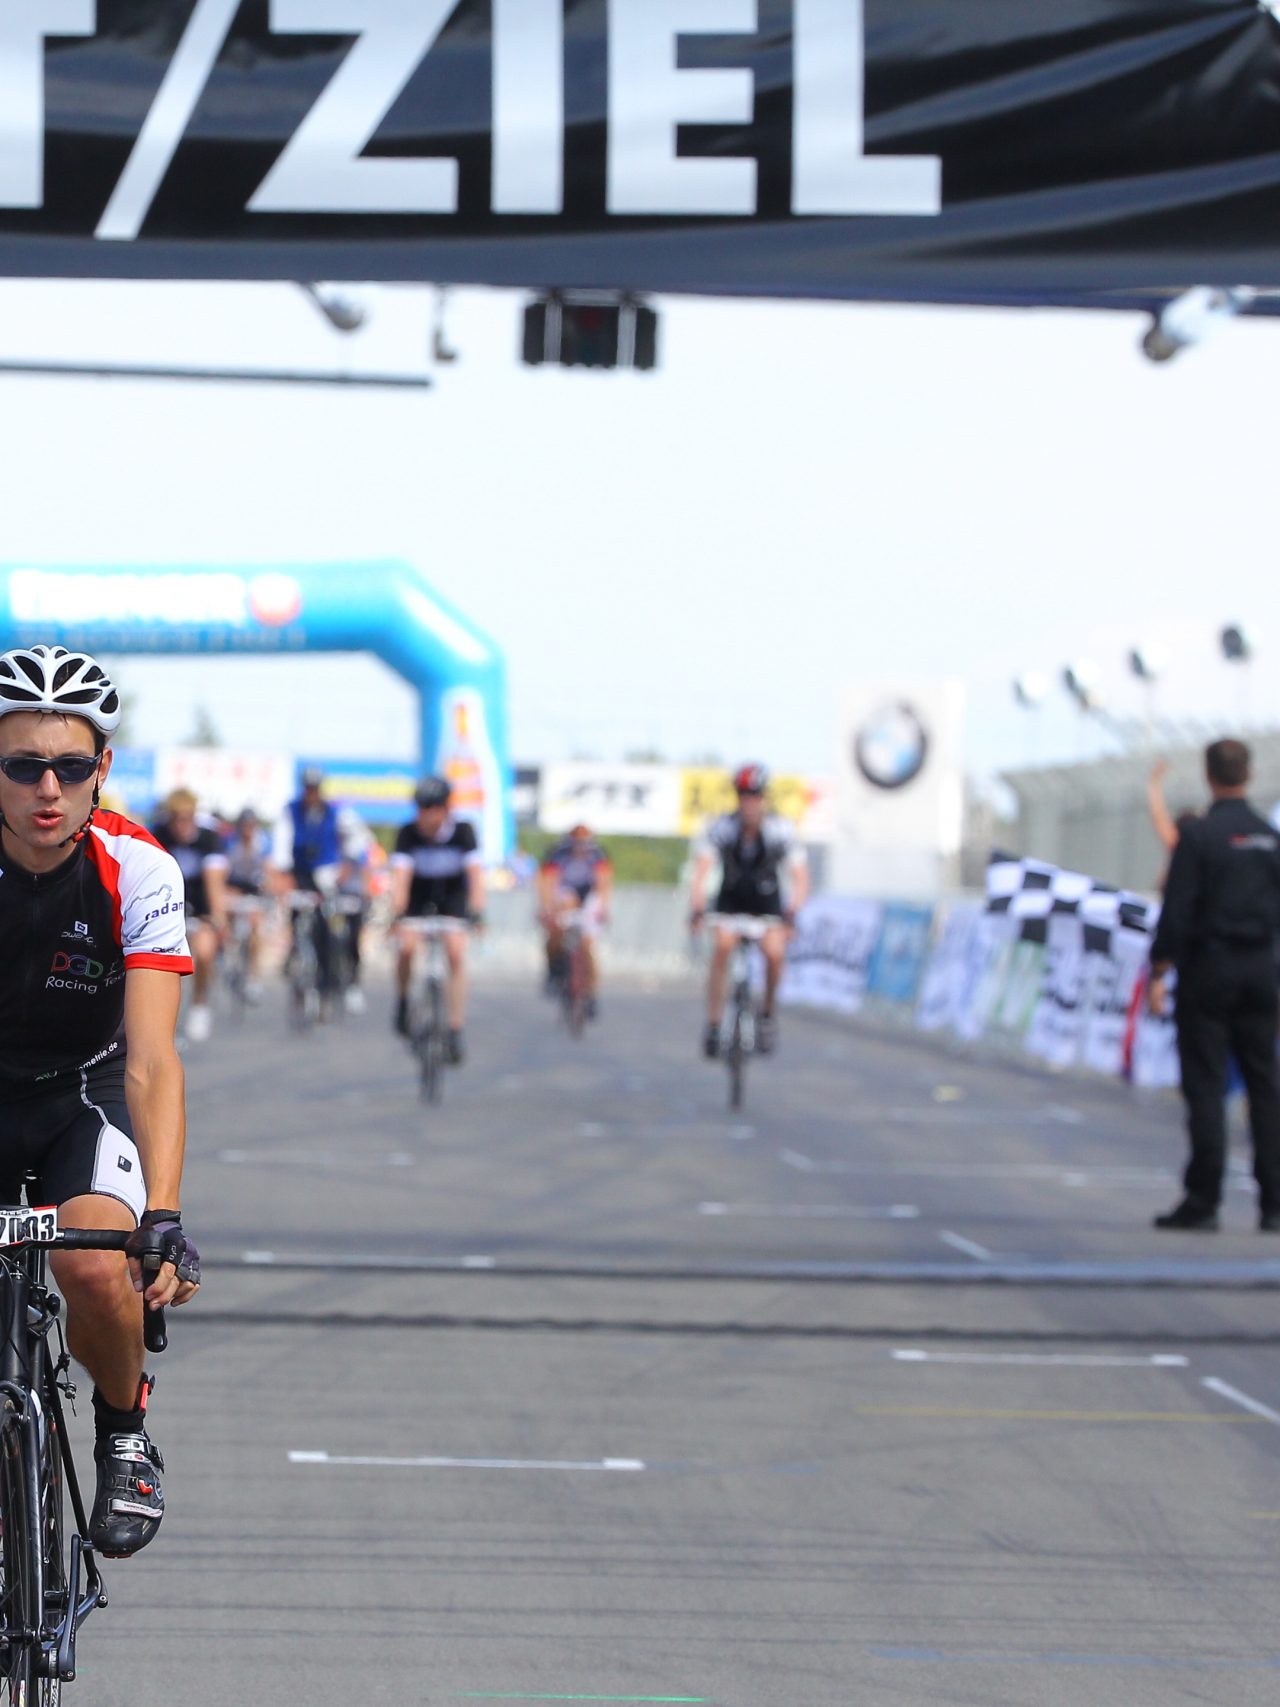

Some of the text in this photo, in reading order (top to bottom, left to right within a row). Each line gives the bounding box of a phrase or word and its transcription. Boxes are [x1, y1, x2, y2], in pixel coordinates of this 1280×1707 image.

[51, 951, 104, 979] DGD
[45, 975, 98, 995] Racing
[115, 1439, 145, 1453] SIDI
